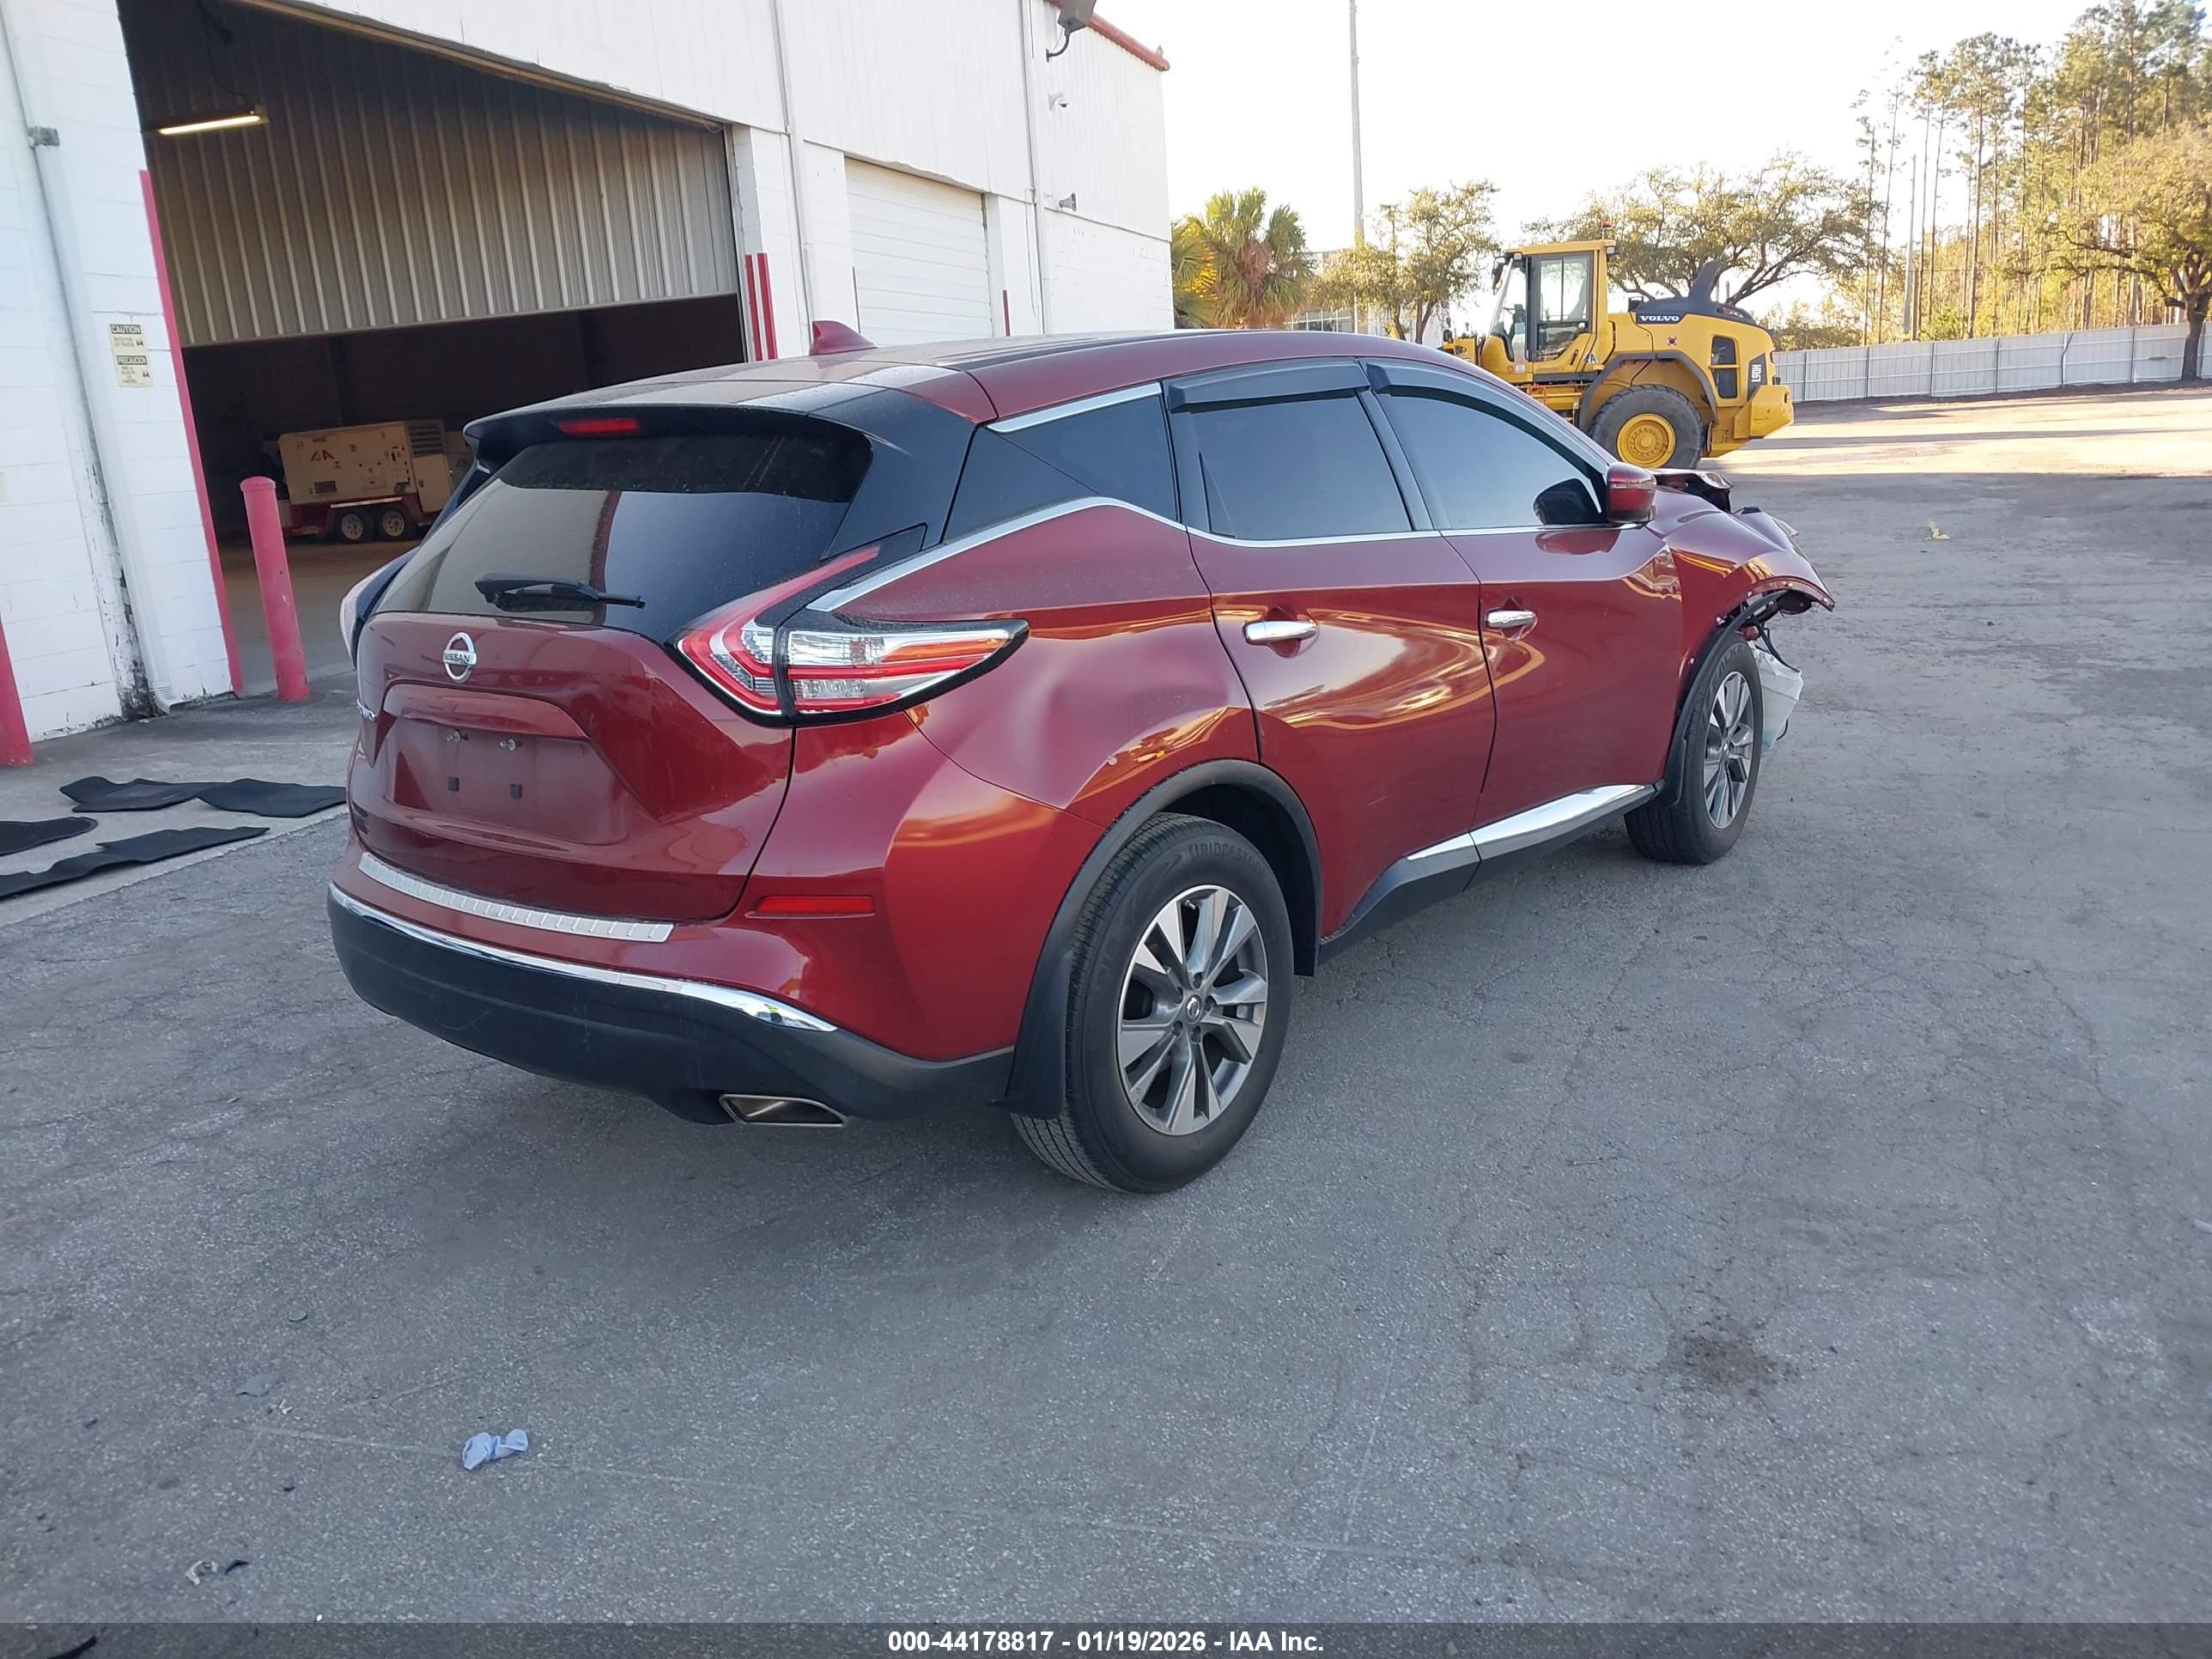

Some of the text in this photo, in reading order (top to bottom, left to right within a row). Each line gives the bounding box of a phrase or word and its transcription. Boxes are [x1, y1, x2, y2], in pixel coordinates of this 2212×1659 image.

[111, 325, 140, 333] CAUTION
[1752, 364, 1761, 382] L90H
[445, 653, 471, 662] NISSAN
